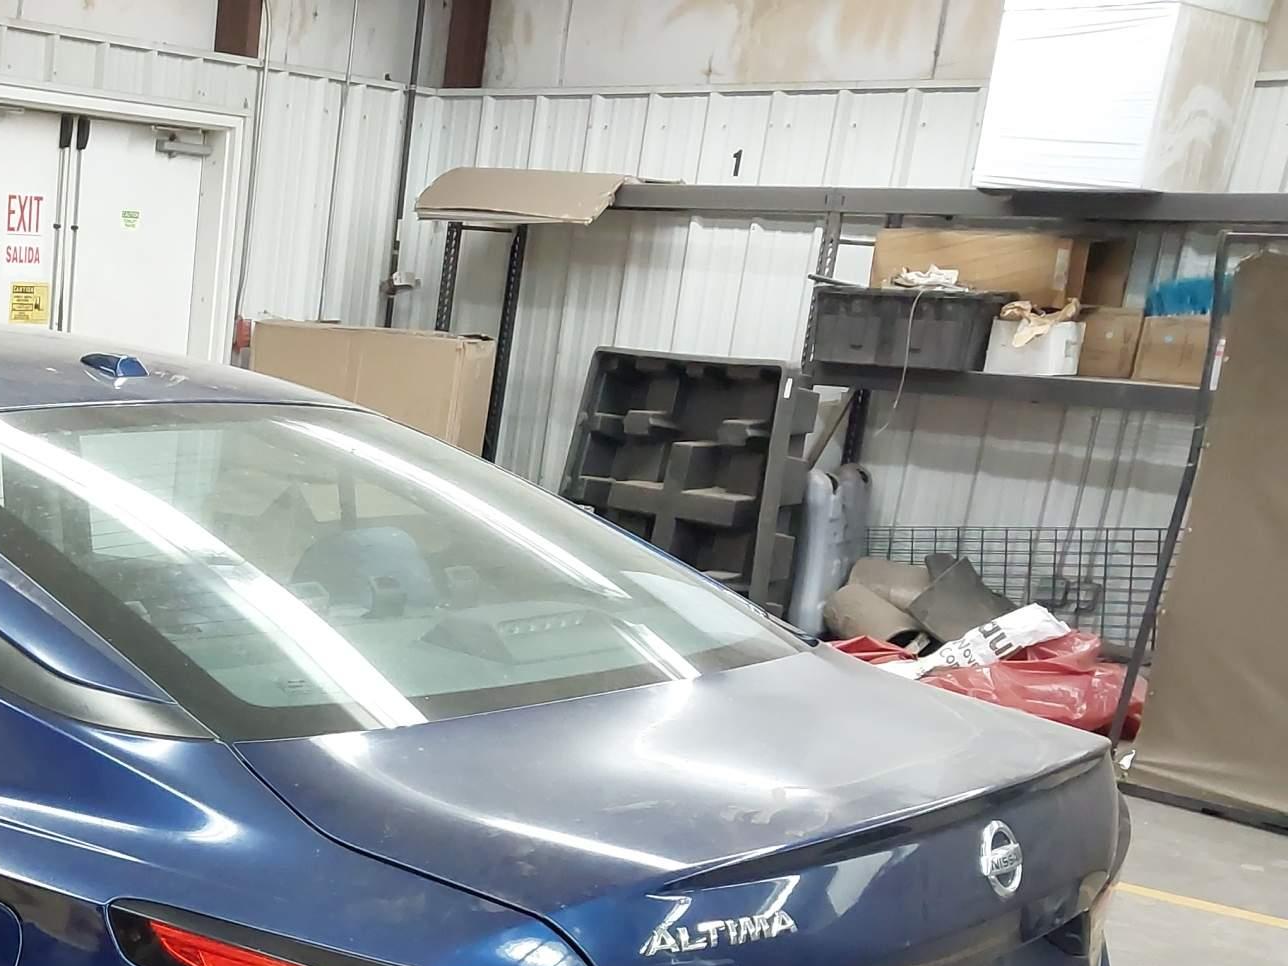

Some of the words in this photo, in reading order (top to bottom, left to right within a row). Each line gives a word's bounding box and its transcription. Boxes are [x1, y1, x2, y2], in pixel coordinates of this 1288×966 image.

[733, 149, 743, 177] 1
[7, 194, 44, 232] EXIT
[5, 245, 40, 264] SALIDA
[640, 910, 798, 956] ALTIMA
